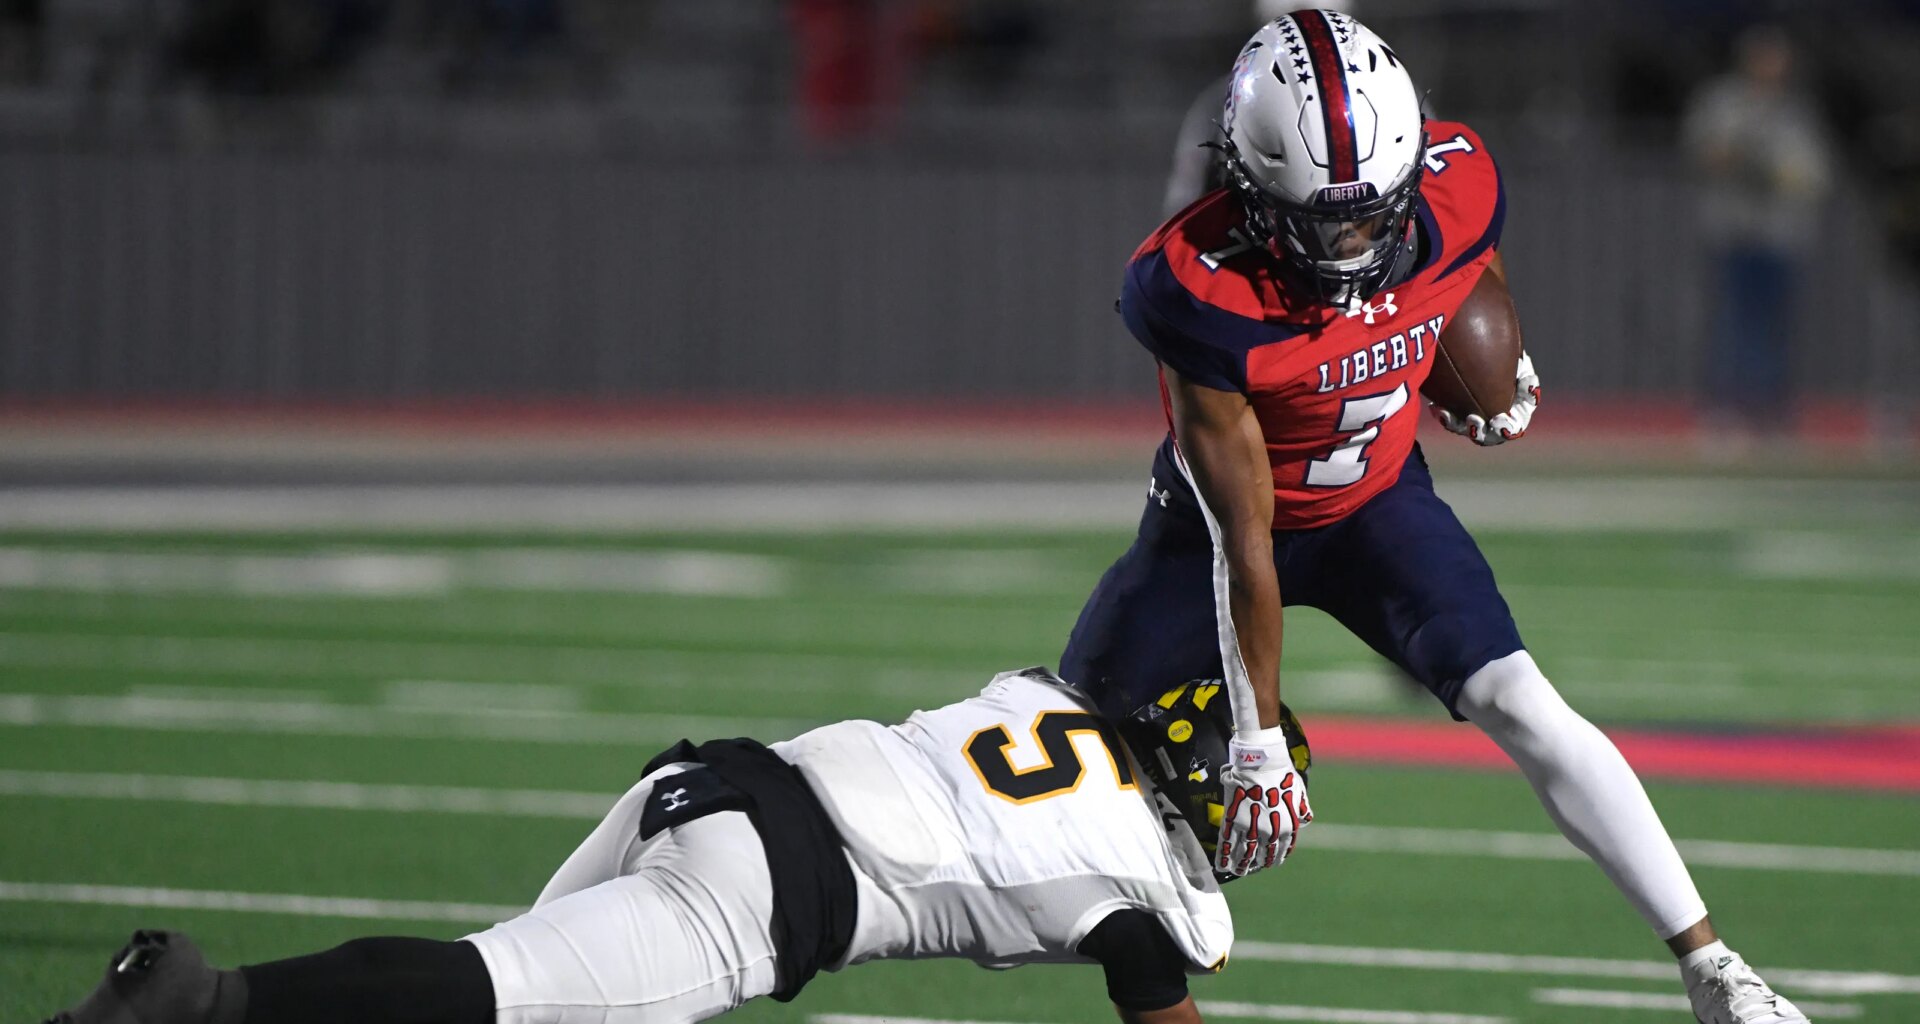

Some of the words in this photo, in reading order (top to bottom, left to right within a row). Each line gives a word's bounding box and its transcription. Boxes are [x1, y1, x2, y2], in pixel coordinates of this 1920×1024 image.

[1424, 134, 1475, 175] 7
[1324, 183, 1368, 202] LIBERTY
[1198, 226, 1251, 273] 7
[1317, 314, 1444, 394] LIBERTY
[1305, 381, 1410, 486] 7
[961, 710, 1142, 806] 5
